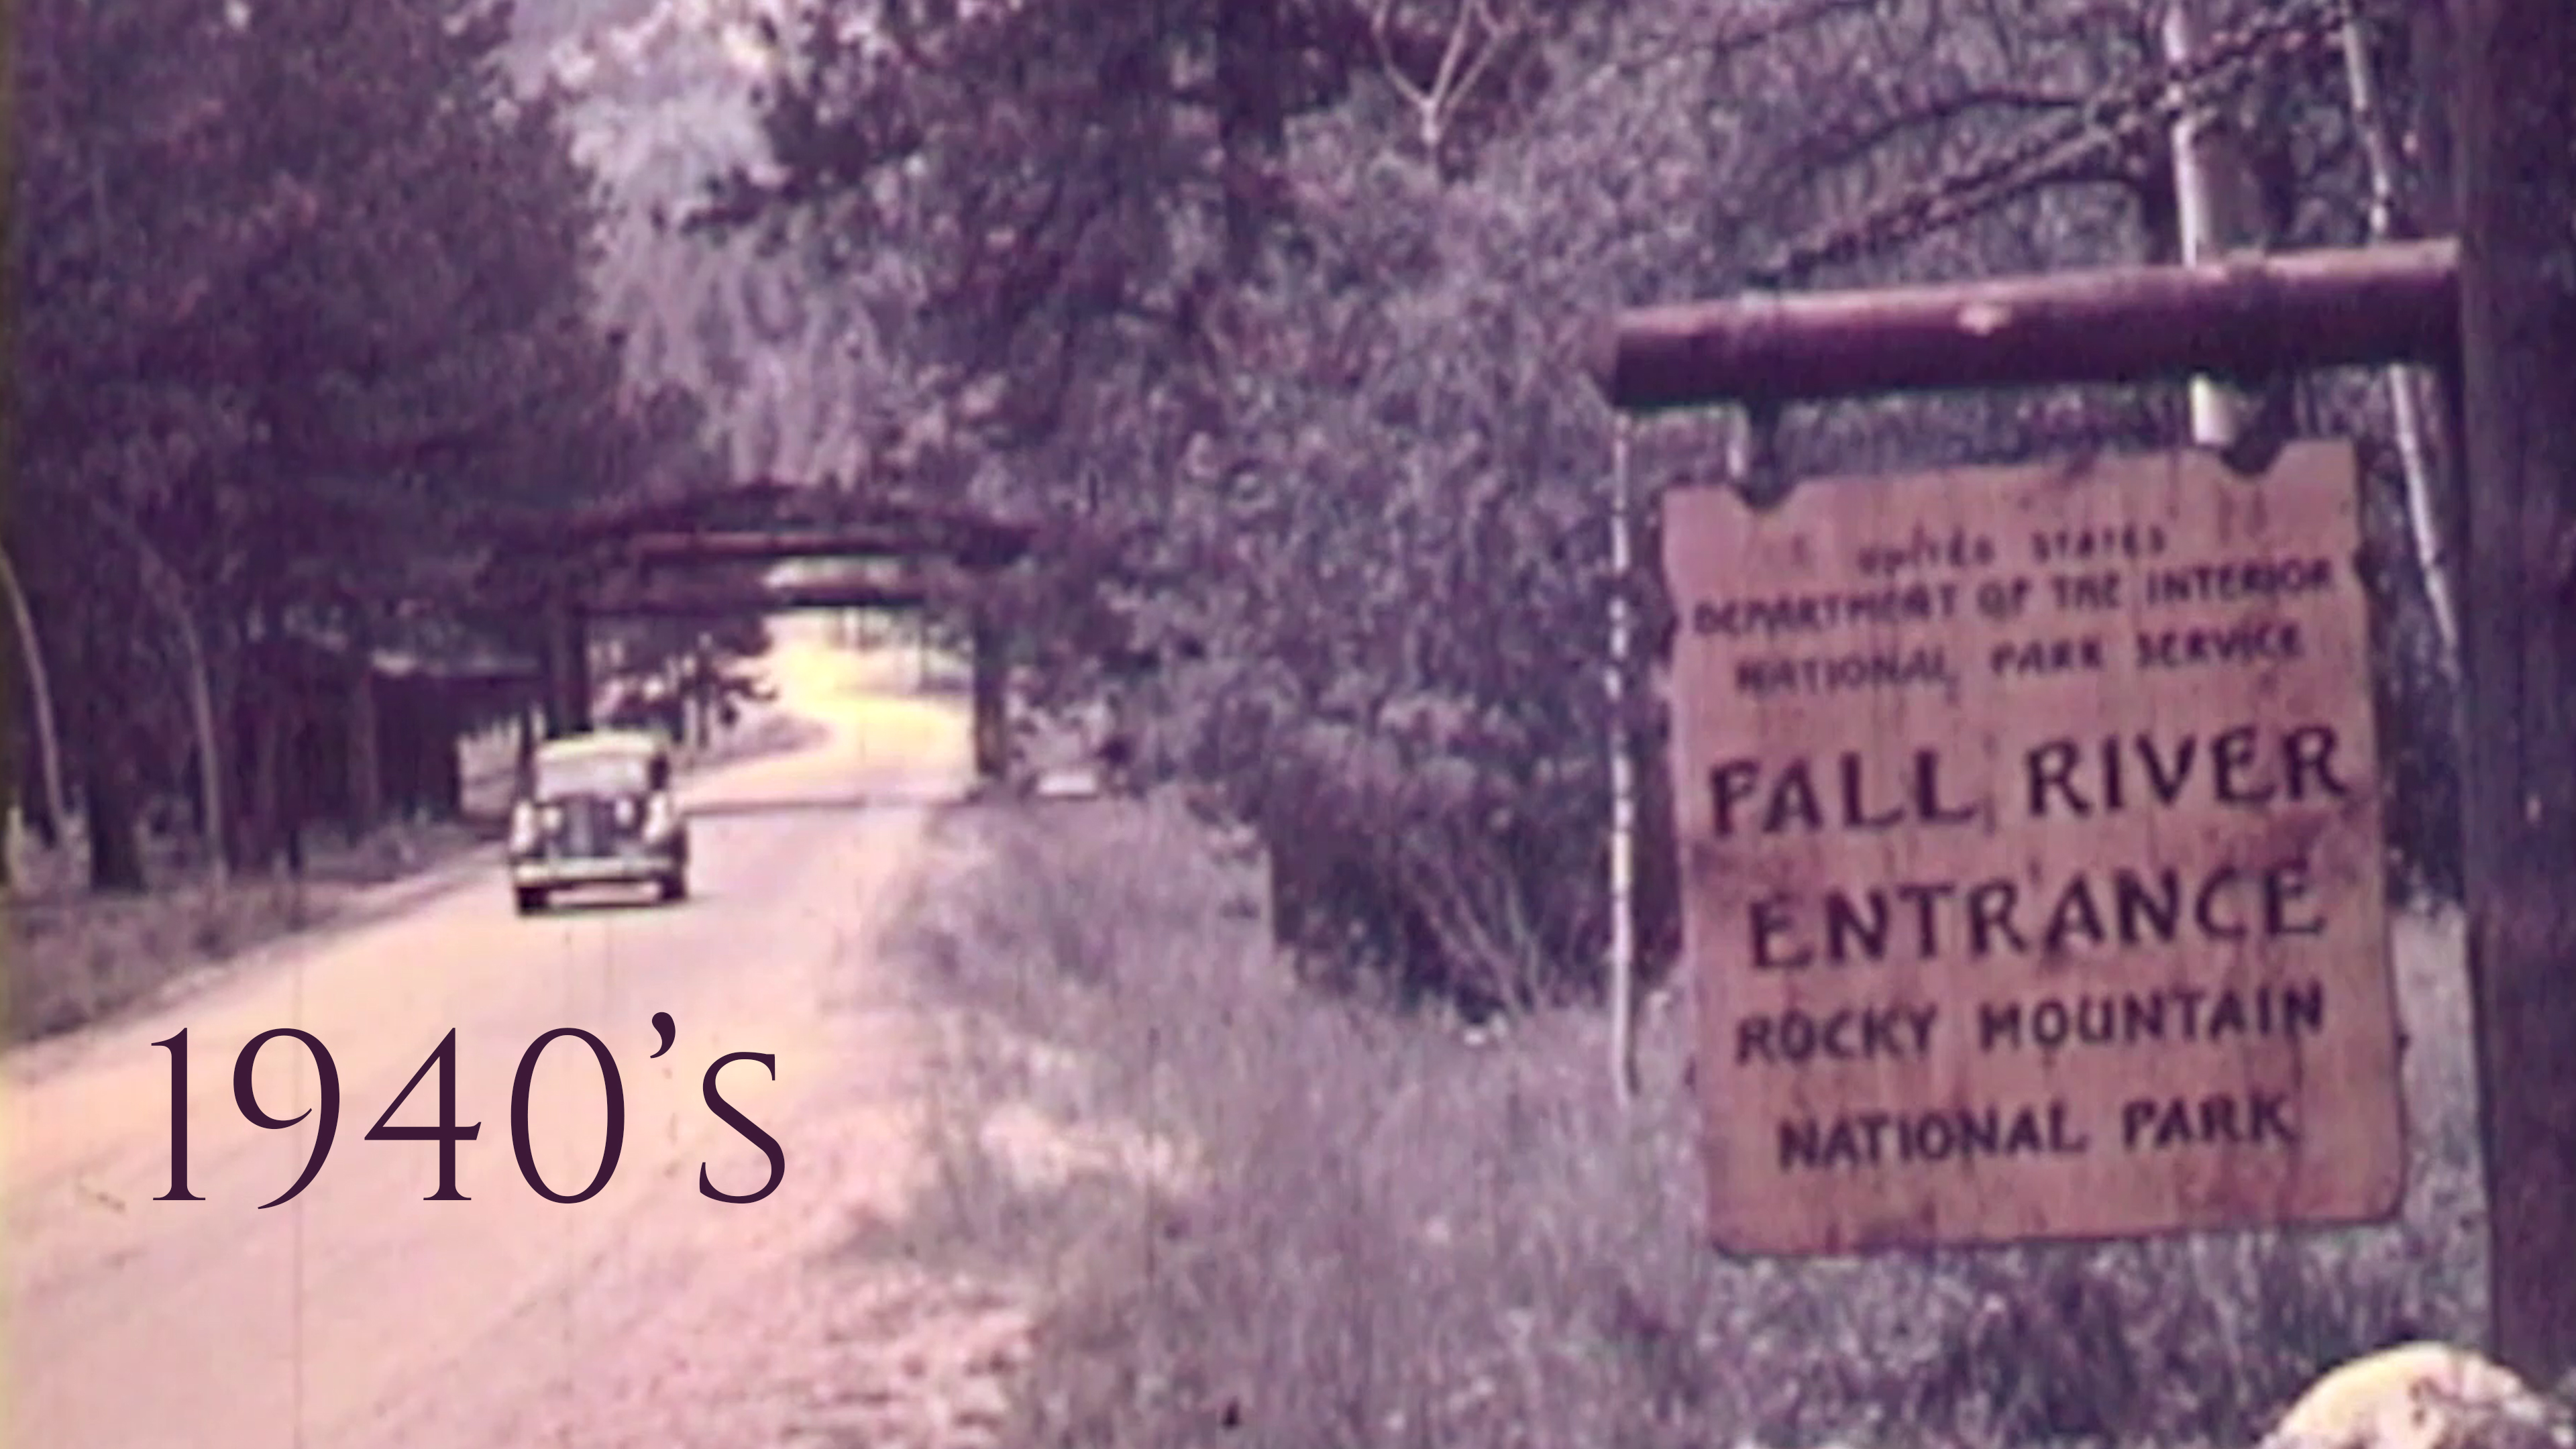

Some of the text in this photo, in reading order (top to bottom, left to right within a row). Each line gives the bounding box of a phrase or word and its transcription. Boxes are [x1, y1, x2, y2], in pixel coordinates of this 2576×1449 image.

[1694, 558, 2333, 635] DEPARTMENT OF THE INTERIOR
[1736, 624, 2304, 694] NATIONAL PARK SERVICE
[1709, 724, 2351, 836] FALL RIVER
[1748, 859, 2328, 971] ENTRANCE
[1736, 982, 2325, 1065] ROCKY MOUNTAIN
[1778, 1092, 2300, 1171] NATIONAL PARK
